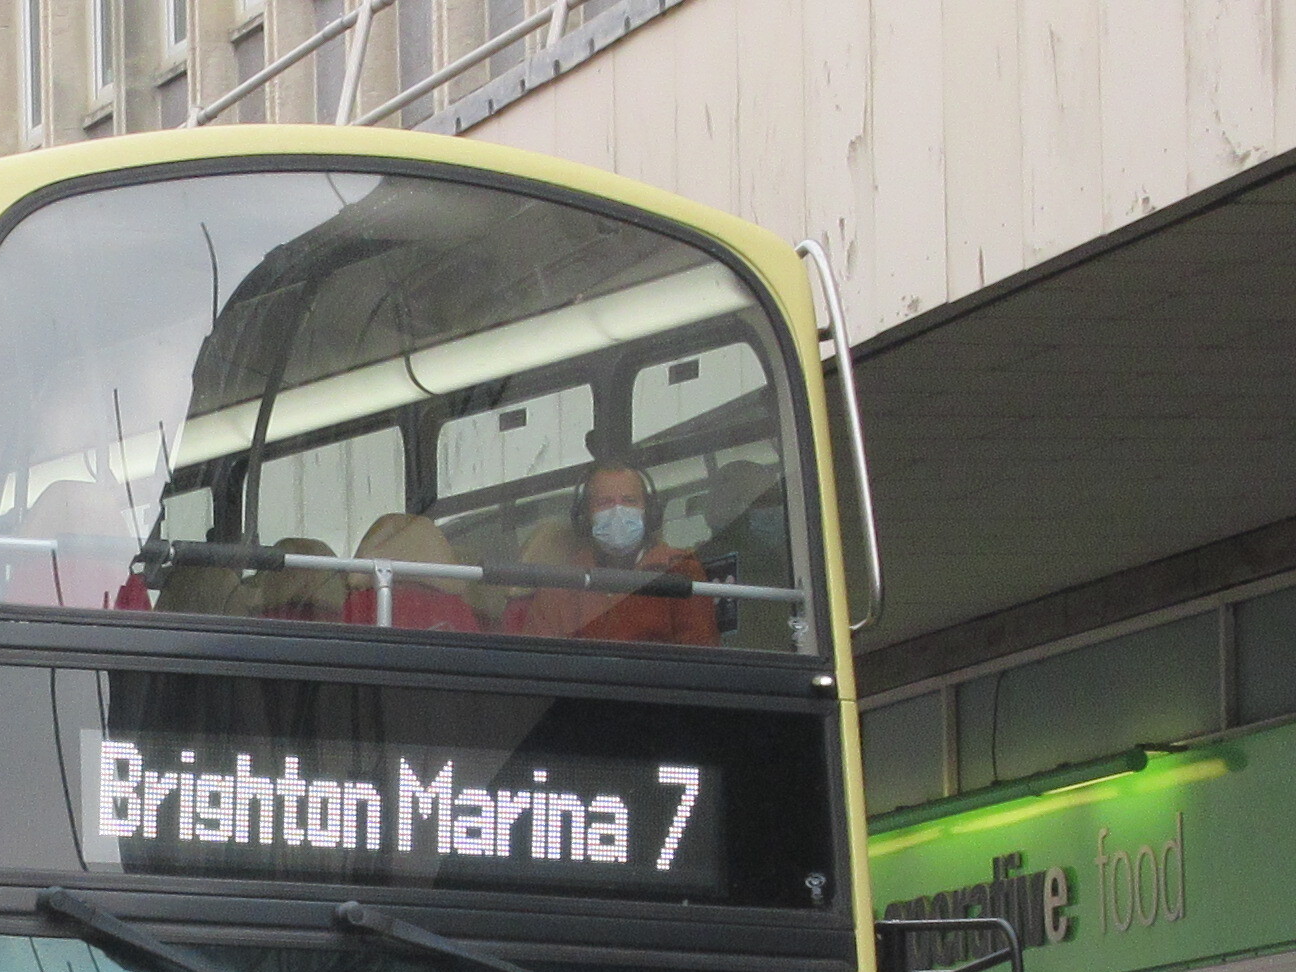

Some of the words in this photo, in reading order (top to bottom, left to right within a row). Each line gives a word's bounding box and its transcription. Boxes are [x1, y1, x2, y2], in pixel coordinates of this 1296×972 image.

[99, 741, 381, 850] Brighton
[398, 757, 628, 863] Marina
[656, 766, 699, 870] 7
[1095, 810, 1187, 934] food
